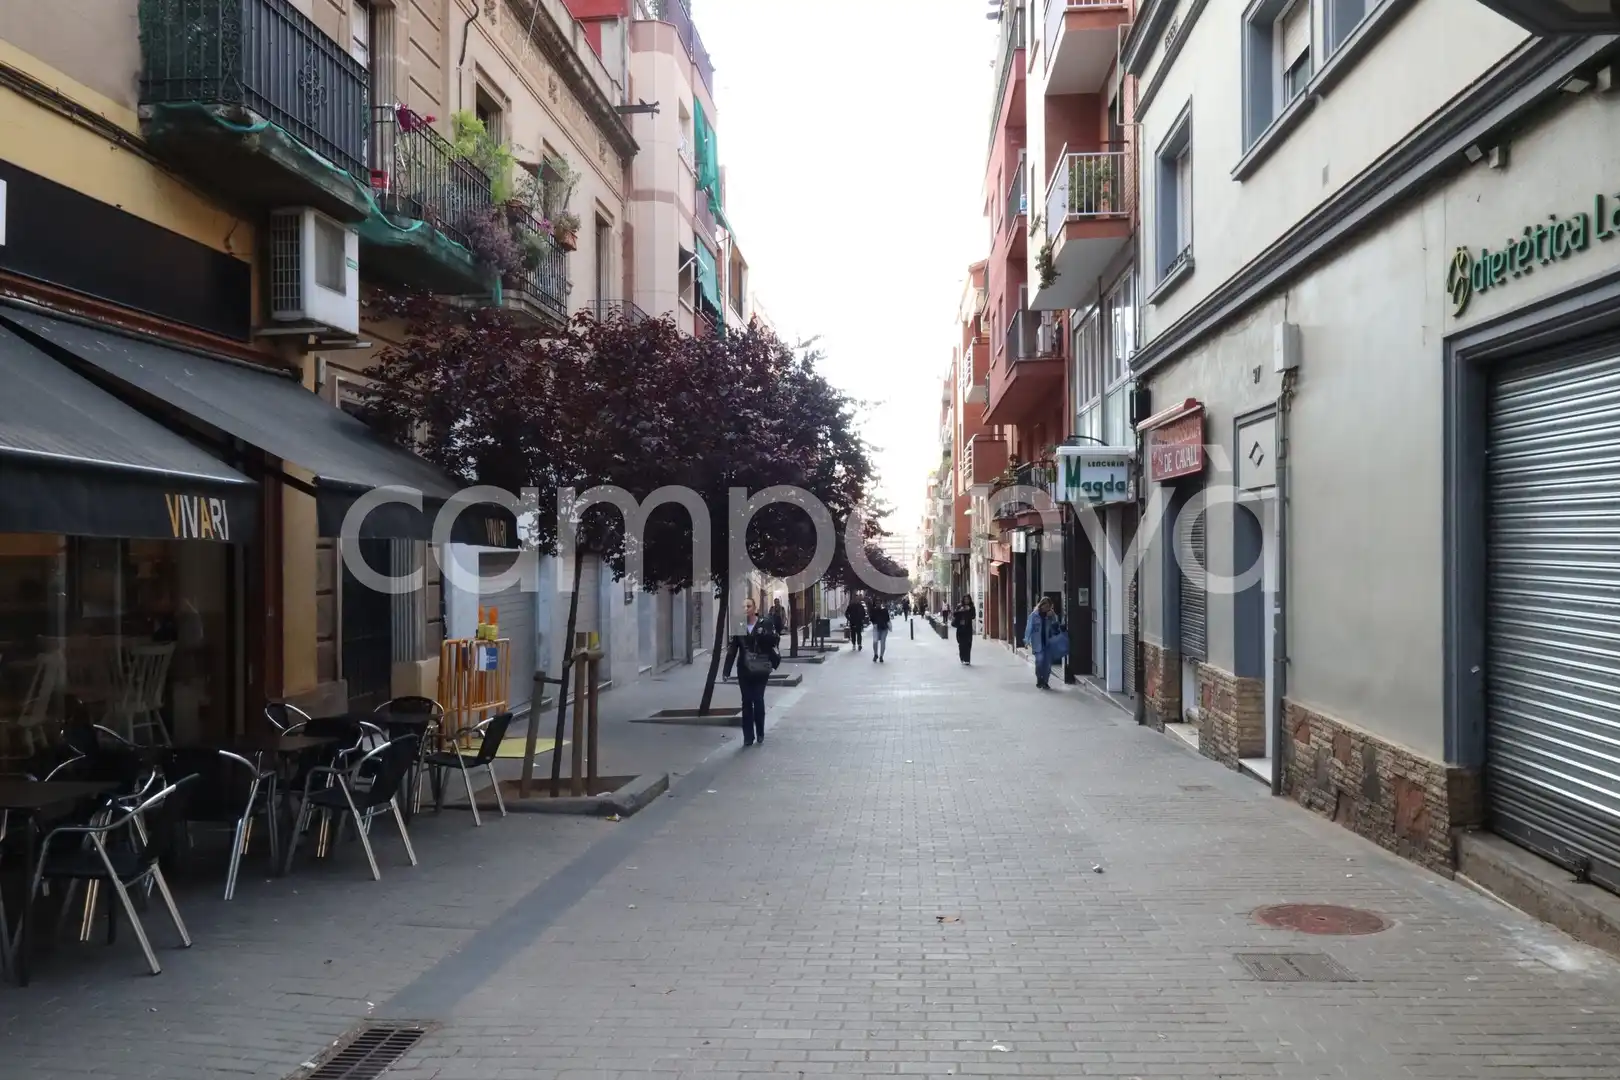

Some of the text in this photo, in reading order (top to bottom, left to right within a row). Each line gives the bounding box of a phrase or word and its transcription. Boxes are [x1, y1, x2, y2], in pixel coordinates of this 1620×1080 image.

[1472, 213, 1587, 292] dietética
[1066, 455, 1126, 502] Magda
[164, 493, 229, 541] VIVARI
